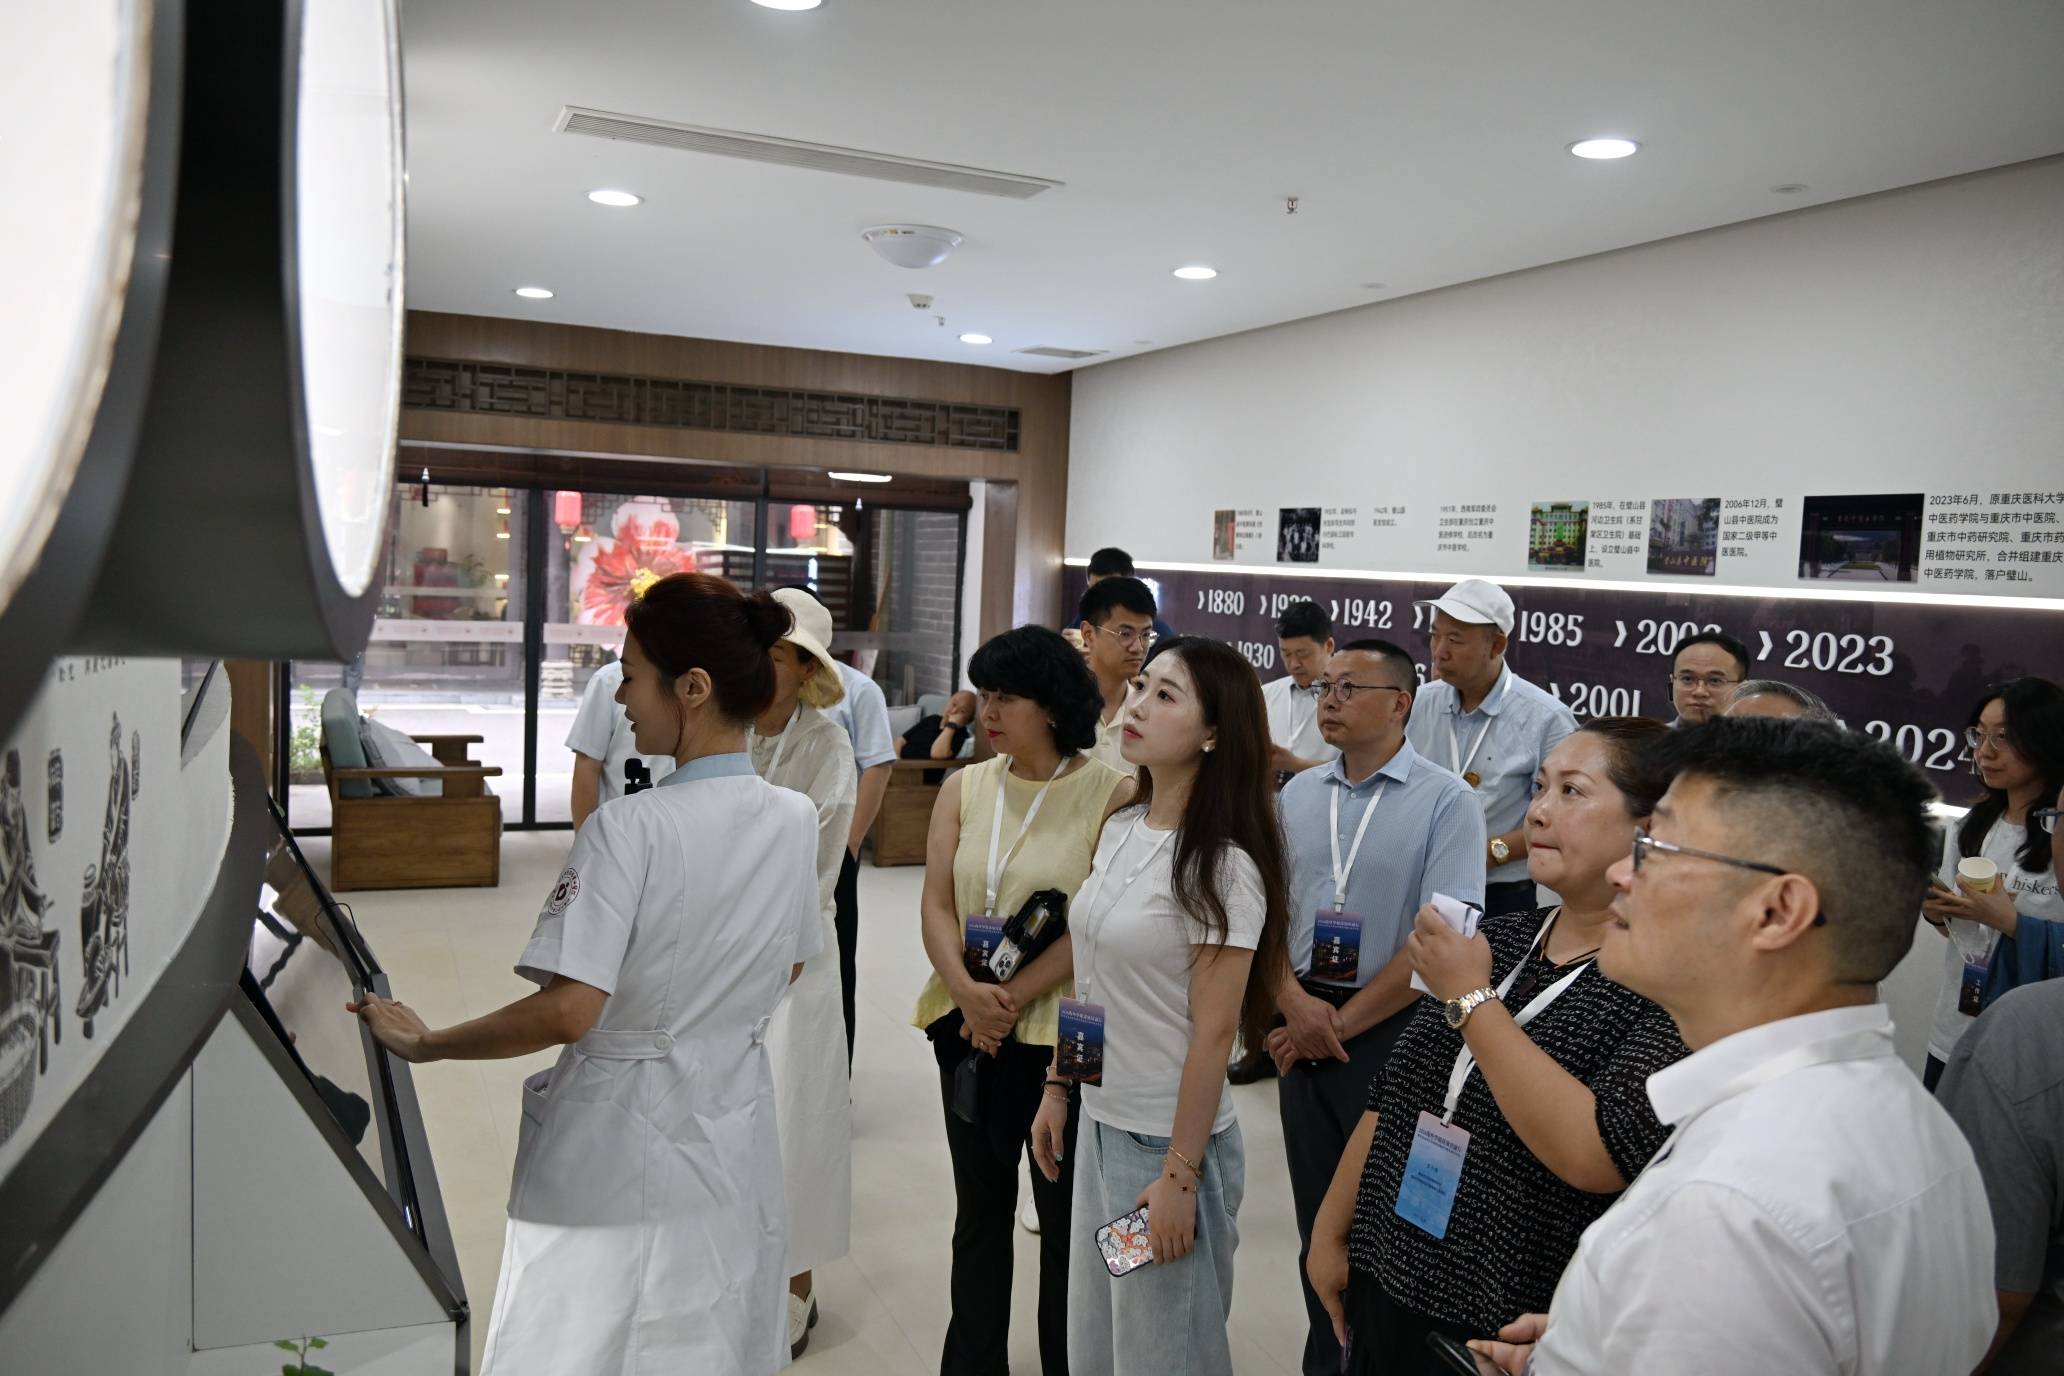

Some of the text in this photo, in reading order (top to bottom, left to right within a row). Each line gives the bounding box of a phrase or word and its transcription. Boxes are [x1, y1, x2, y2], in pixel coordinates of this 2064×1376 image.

[1722, 531, 1778, 541] 国家二级甲等中
[1208, 589, 1245, 616] 1880
[1343, 598, 1393, 629] 1942
[1519, 610, 1584, 647] 1985
[1783, 629, 1895, 677] 2023
